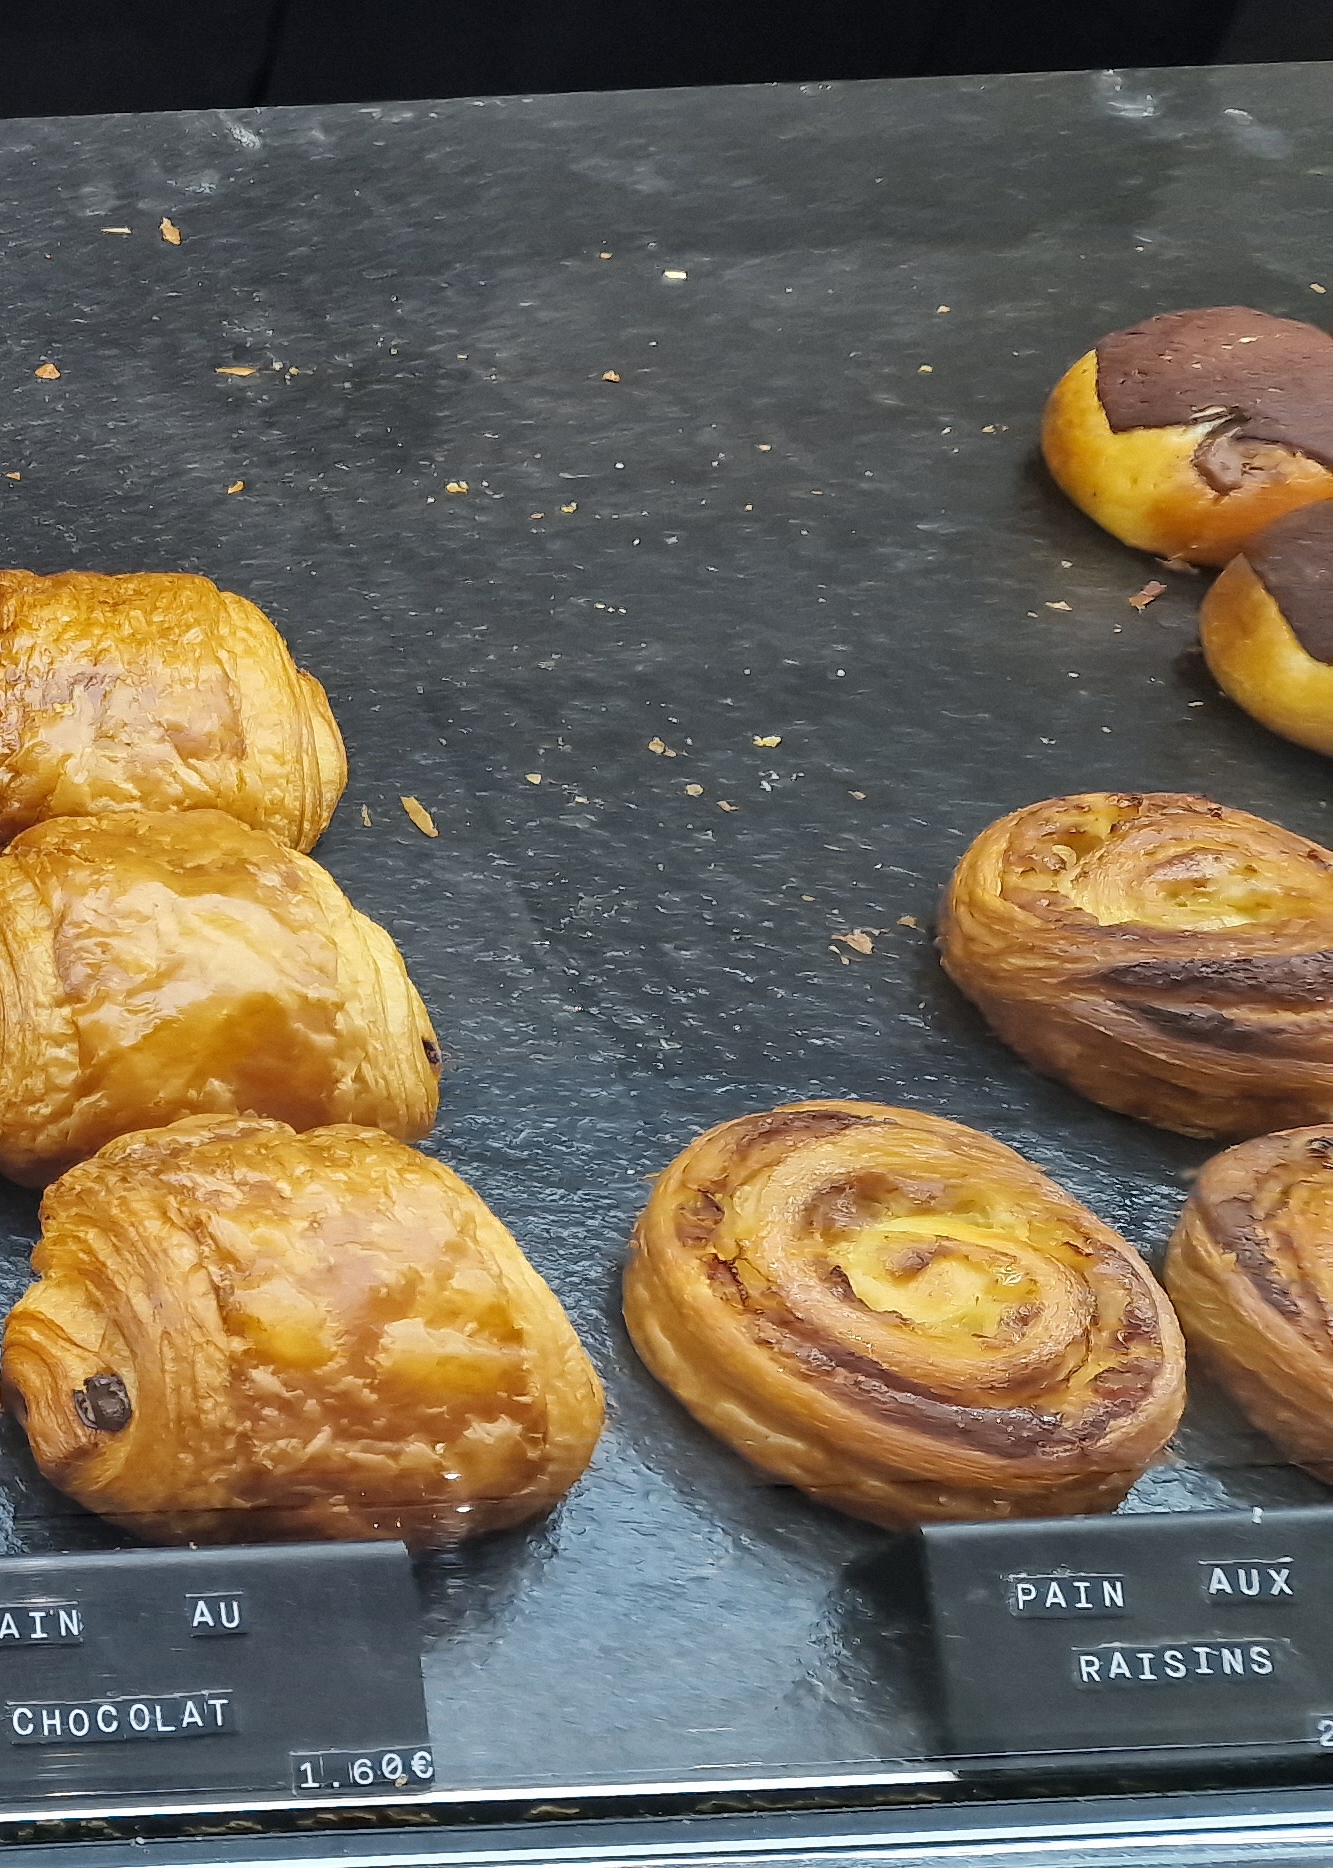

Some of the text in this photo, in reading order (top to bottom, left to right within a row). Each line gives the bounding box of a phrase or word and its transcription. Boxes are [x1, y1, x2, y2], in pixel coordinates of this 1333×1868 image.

[1016, 1567, 1295, 1611] PAIN AUX
[192, 1600, 242, 1629] AU
[1079, 1646, 1275, 1683] RAISINS
[12, 1699, 230, 1737] CHOCOLAT
[299, 1750, 434, 1788] 1.60€
